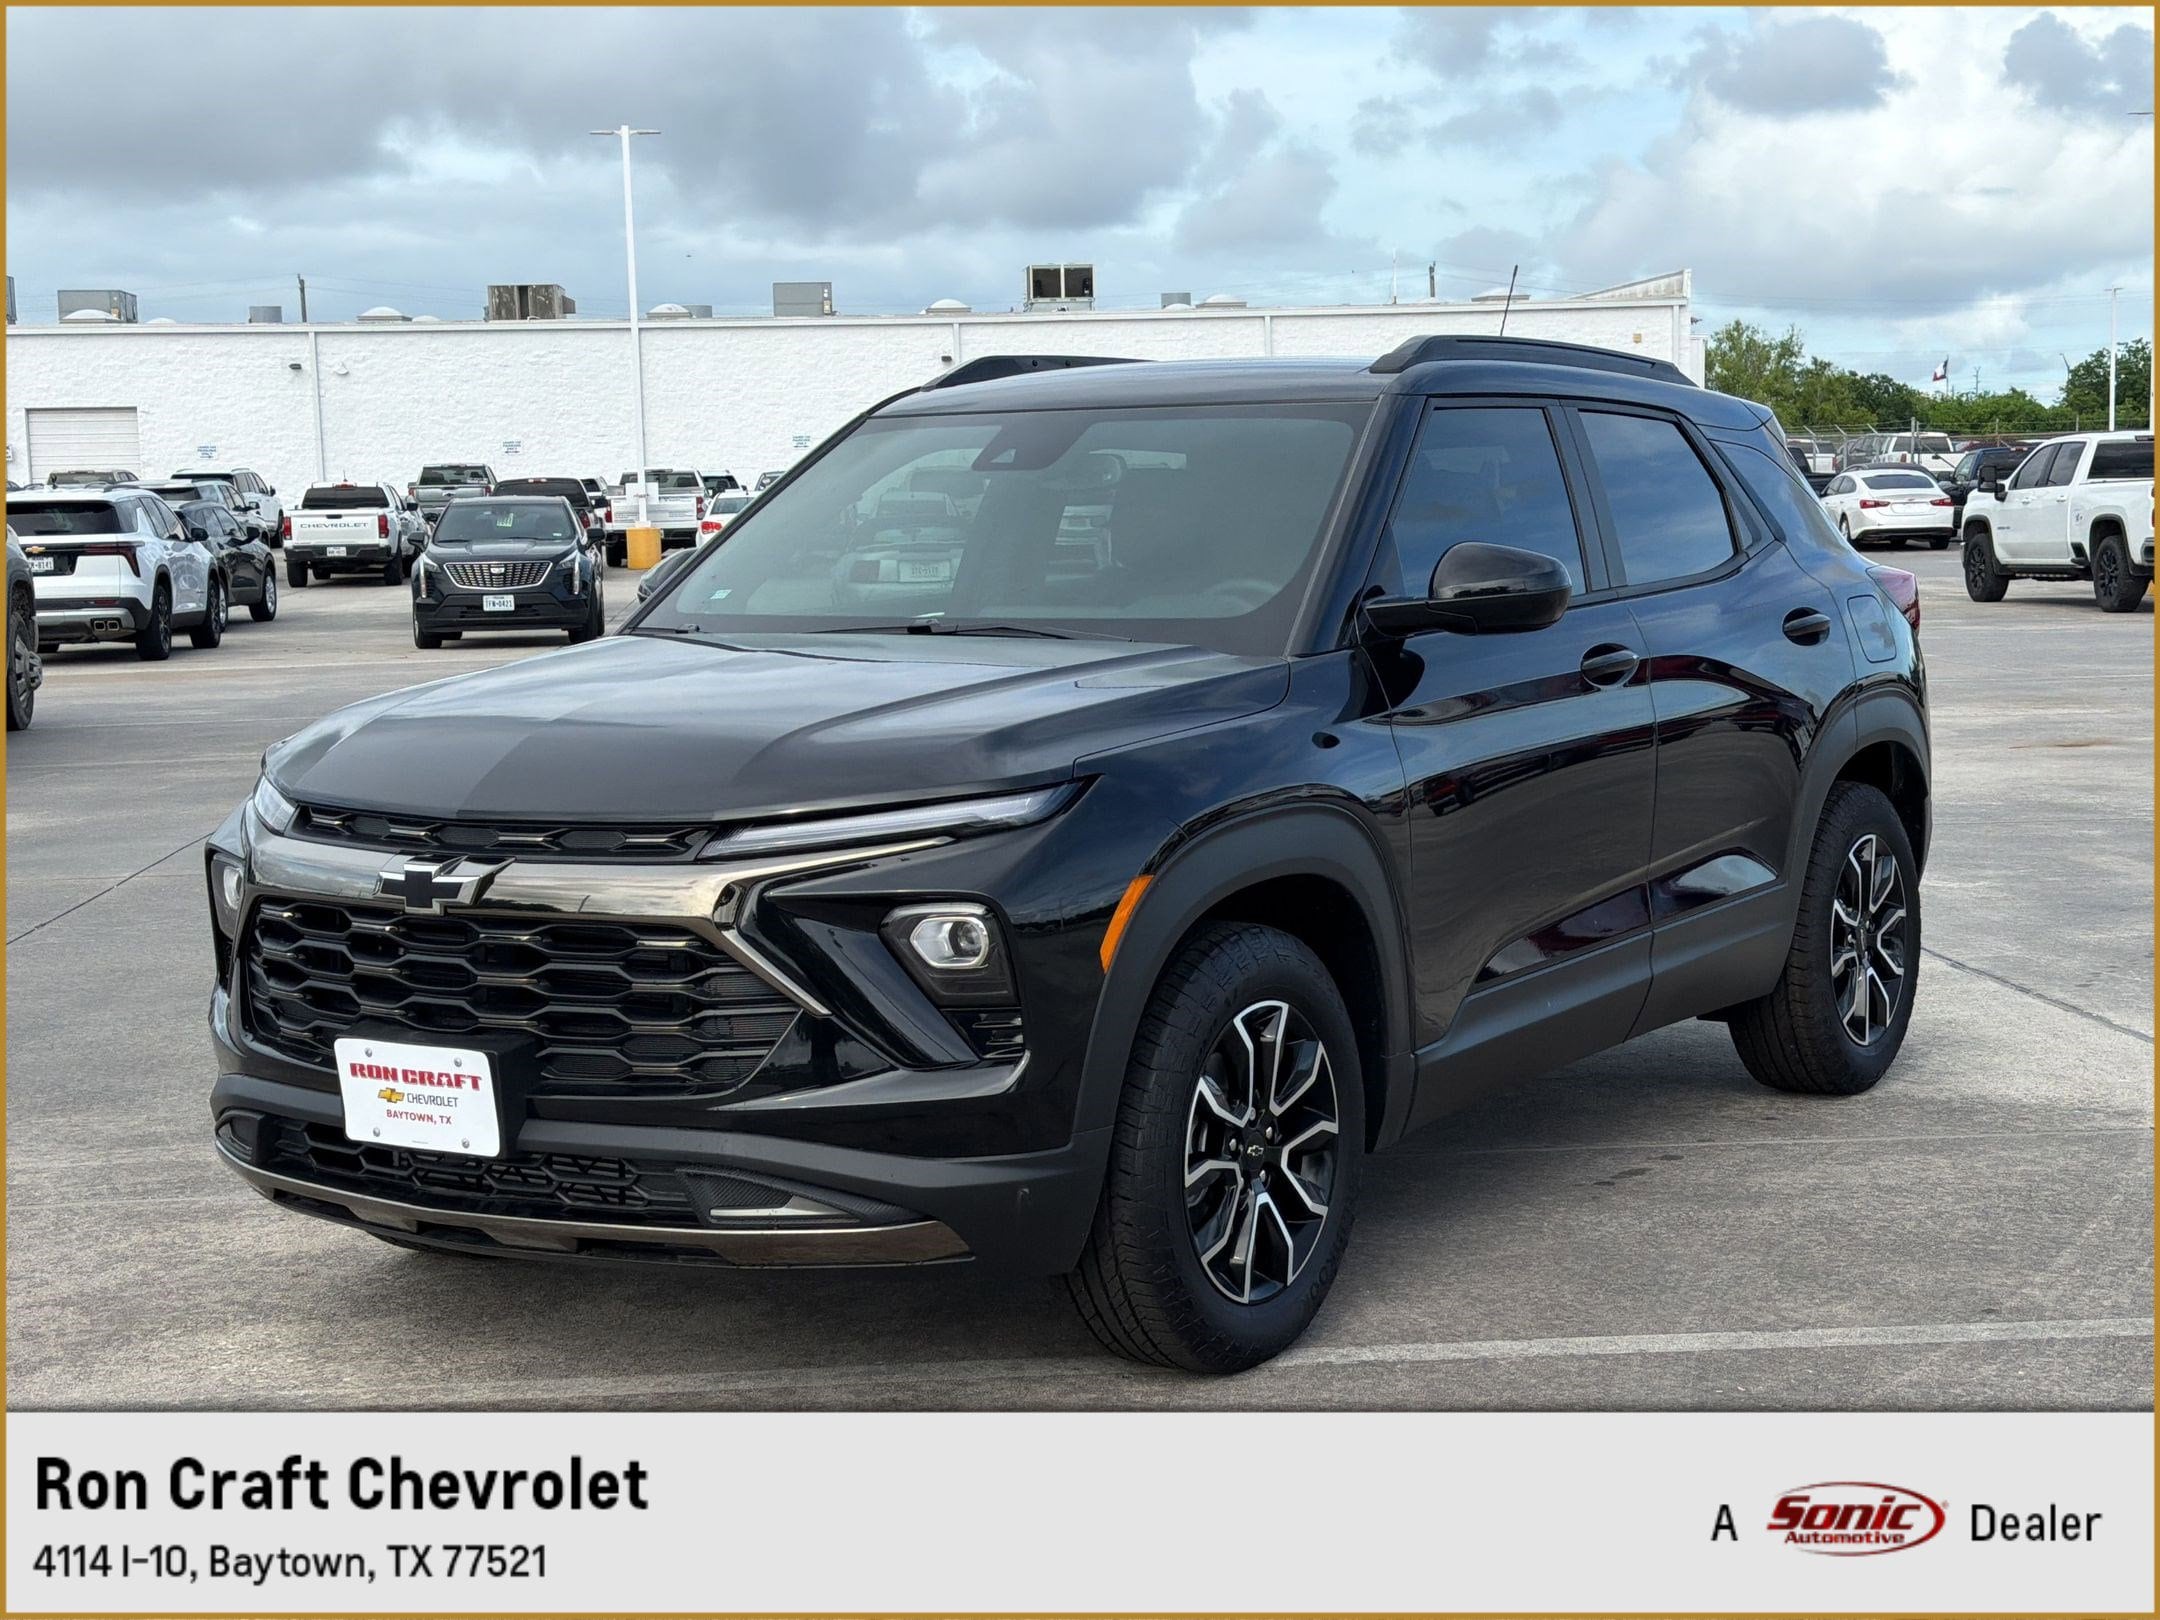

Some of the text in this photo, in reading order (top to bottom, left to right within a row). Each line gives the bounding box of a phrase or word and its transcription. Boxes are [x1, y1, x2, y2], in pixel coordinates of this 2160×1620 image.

[349, 1063, 482, 1091] RON CRAFT
[407, 1093, 459, 1107] CHEVROLET
[386, 1109, 452, 1125] BAYTOWN, TX
